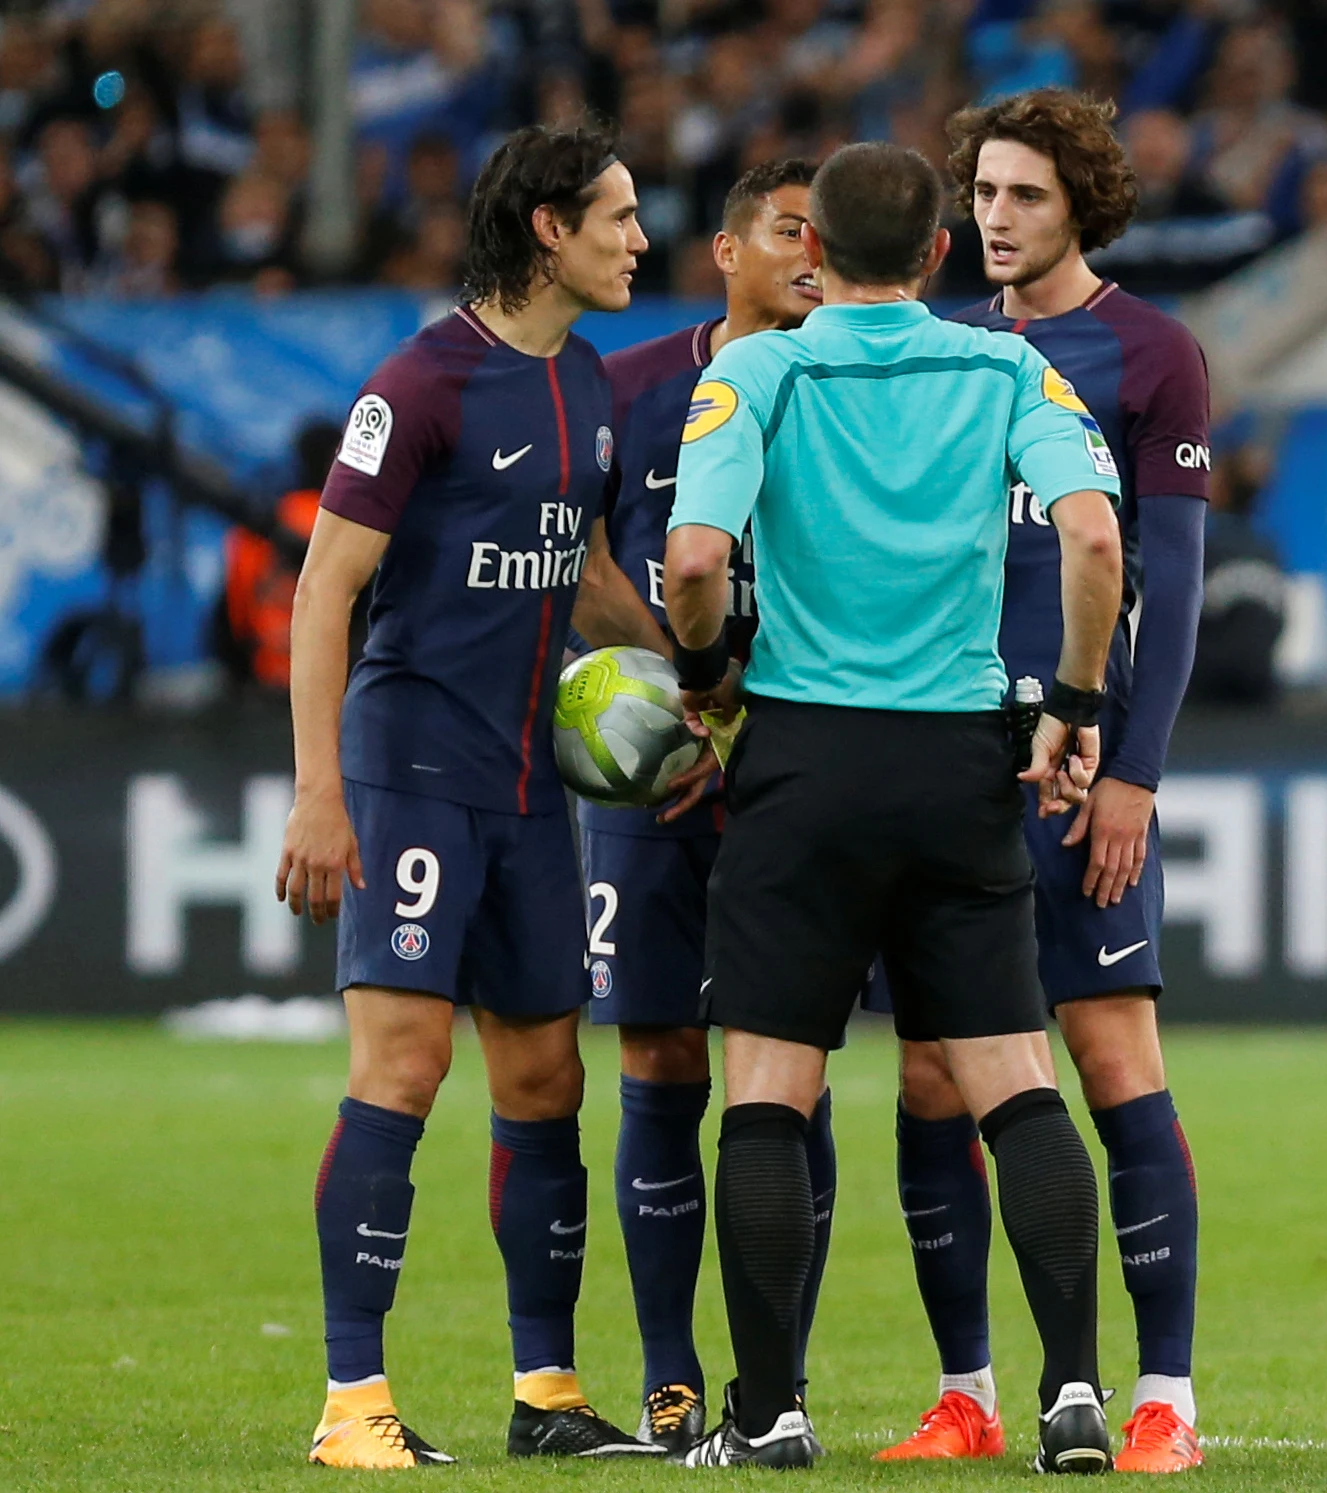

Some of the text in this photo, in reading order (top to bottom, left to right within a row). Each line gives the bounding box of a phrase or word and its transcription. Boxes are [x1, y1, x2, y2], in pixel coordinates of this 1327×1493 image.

[1175, 443, 1211, 472] QN
[539, 502, 582, 540] Fly
[467, 539, 587, 589] Emirat
[394, 847, 440, 919] 9
[589, 881, 619, 956] 2
[638, 1199, 699, 1217] PARIS
[1122, 1246, 1170, 1265] ARIS
